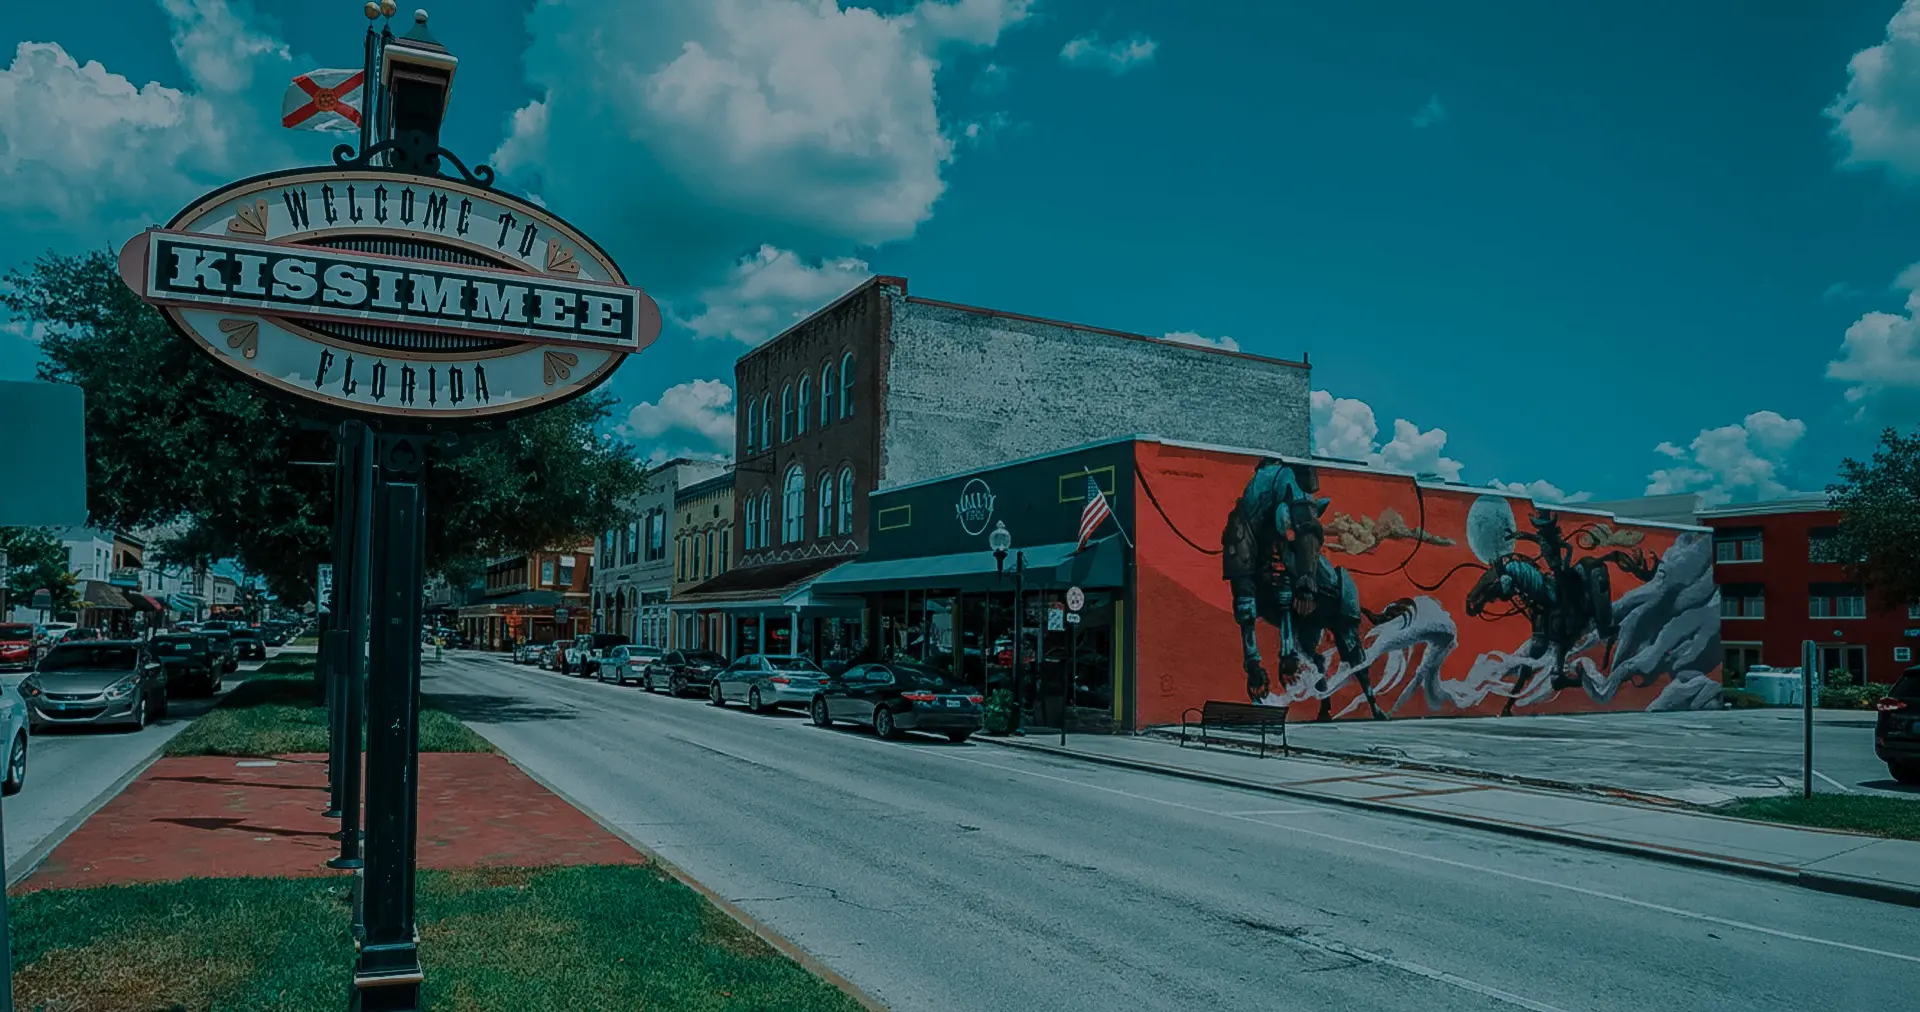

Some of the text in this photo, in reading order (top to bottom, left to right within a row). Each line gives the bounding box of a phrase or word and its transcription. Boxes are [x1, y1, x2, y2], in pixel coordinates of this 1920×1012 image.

[281, 182, 539, 259] WELCOME TO
[168, 246, 623, 334] KISSIMMEE
[314, 347, 491, 408] FLORIDA
